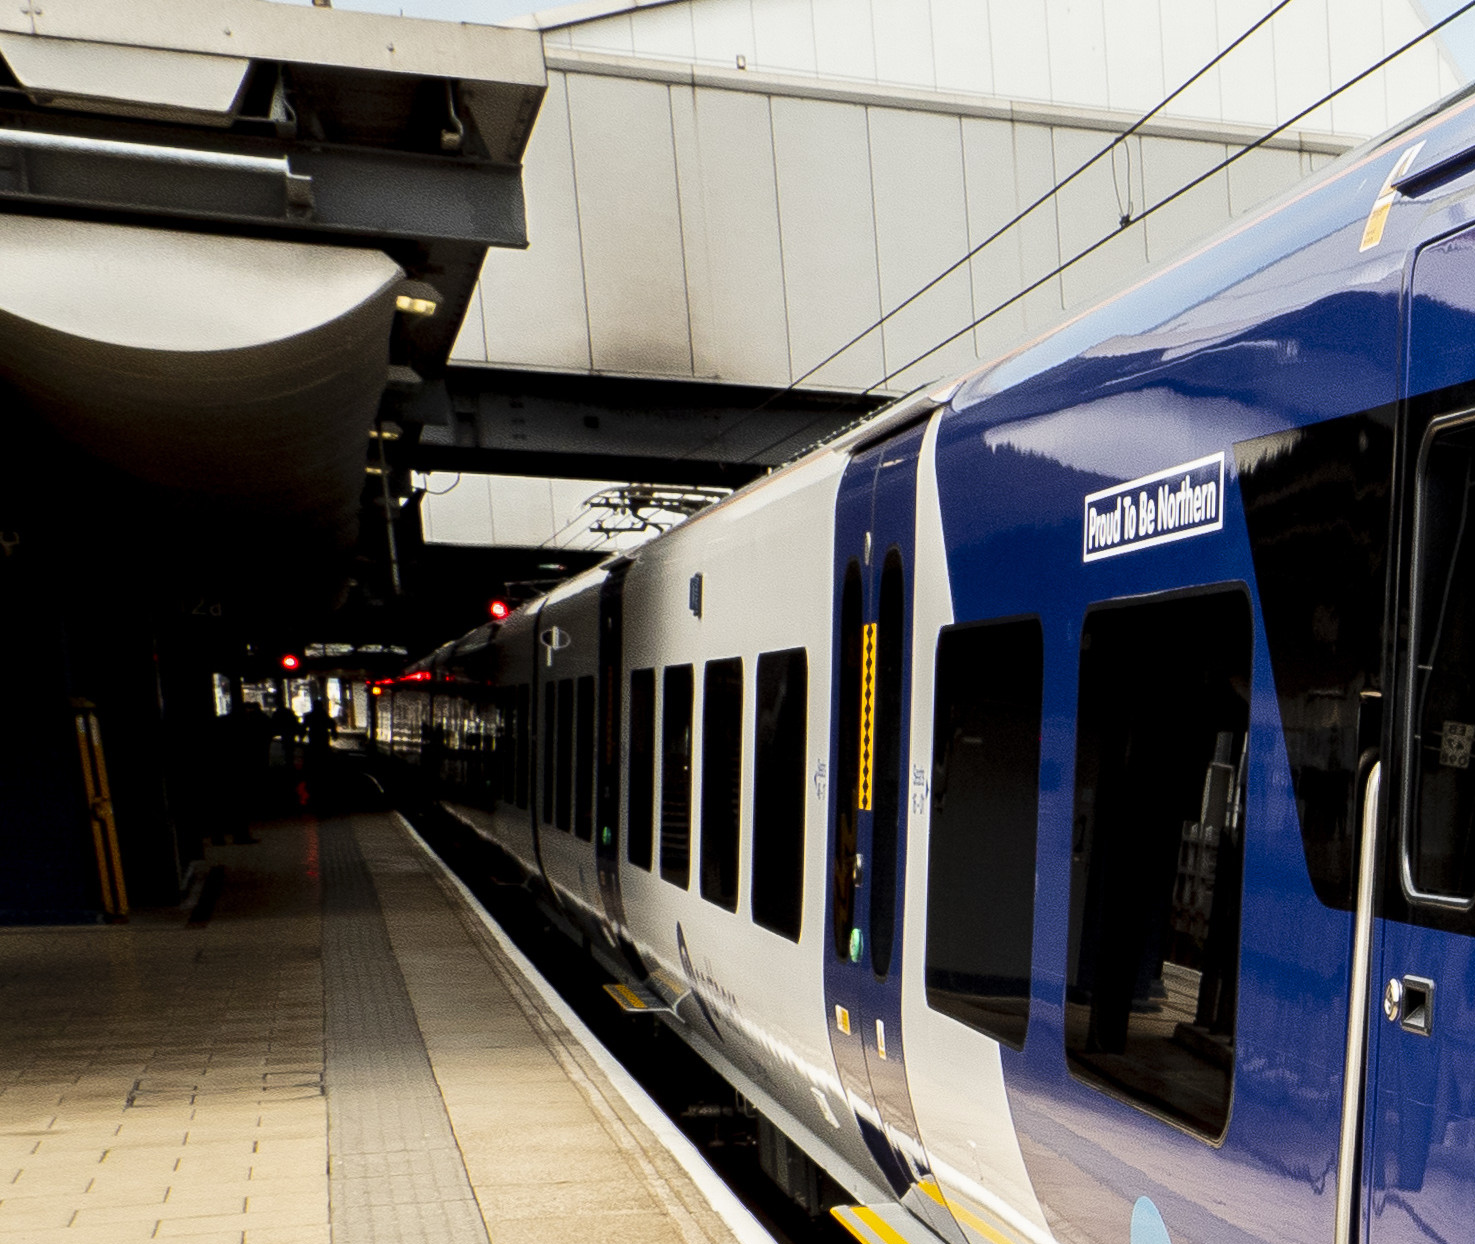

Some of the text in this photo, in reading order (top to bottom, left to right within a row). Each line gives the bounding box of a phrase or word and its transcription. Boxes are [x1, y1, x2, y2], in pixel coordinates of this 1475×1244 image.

[1088, 474, 1217, 550] Proud To Be Northern
